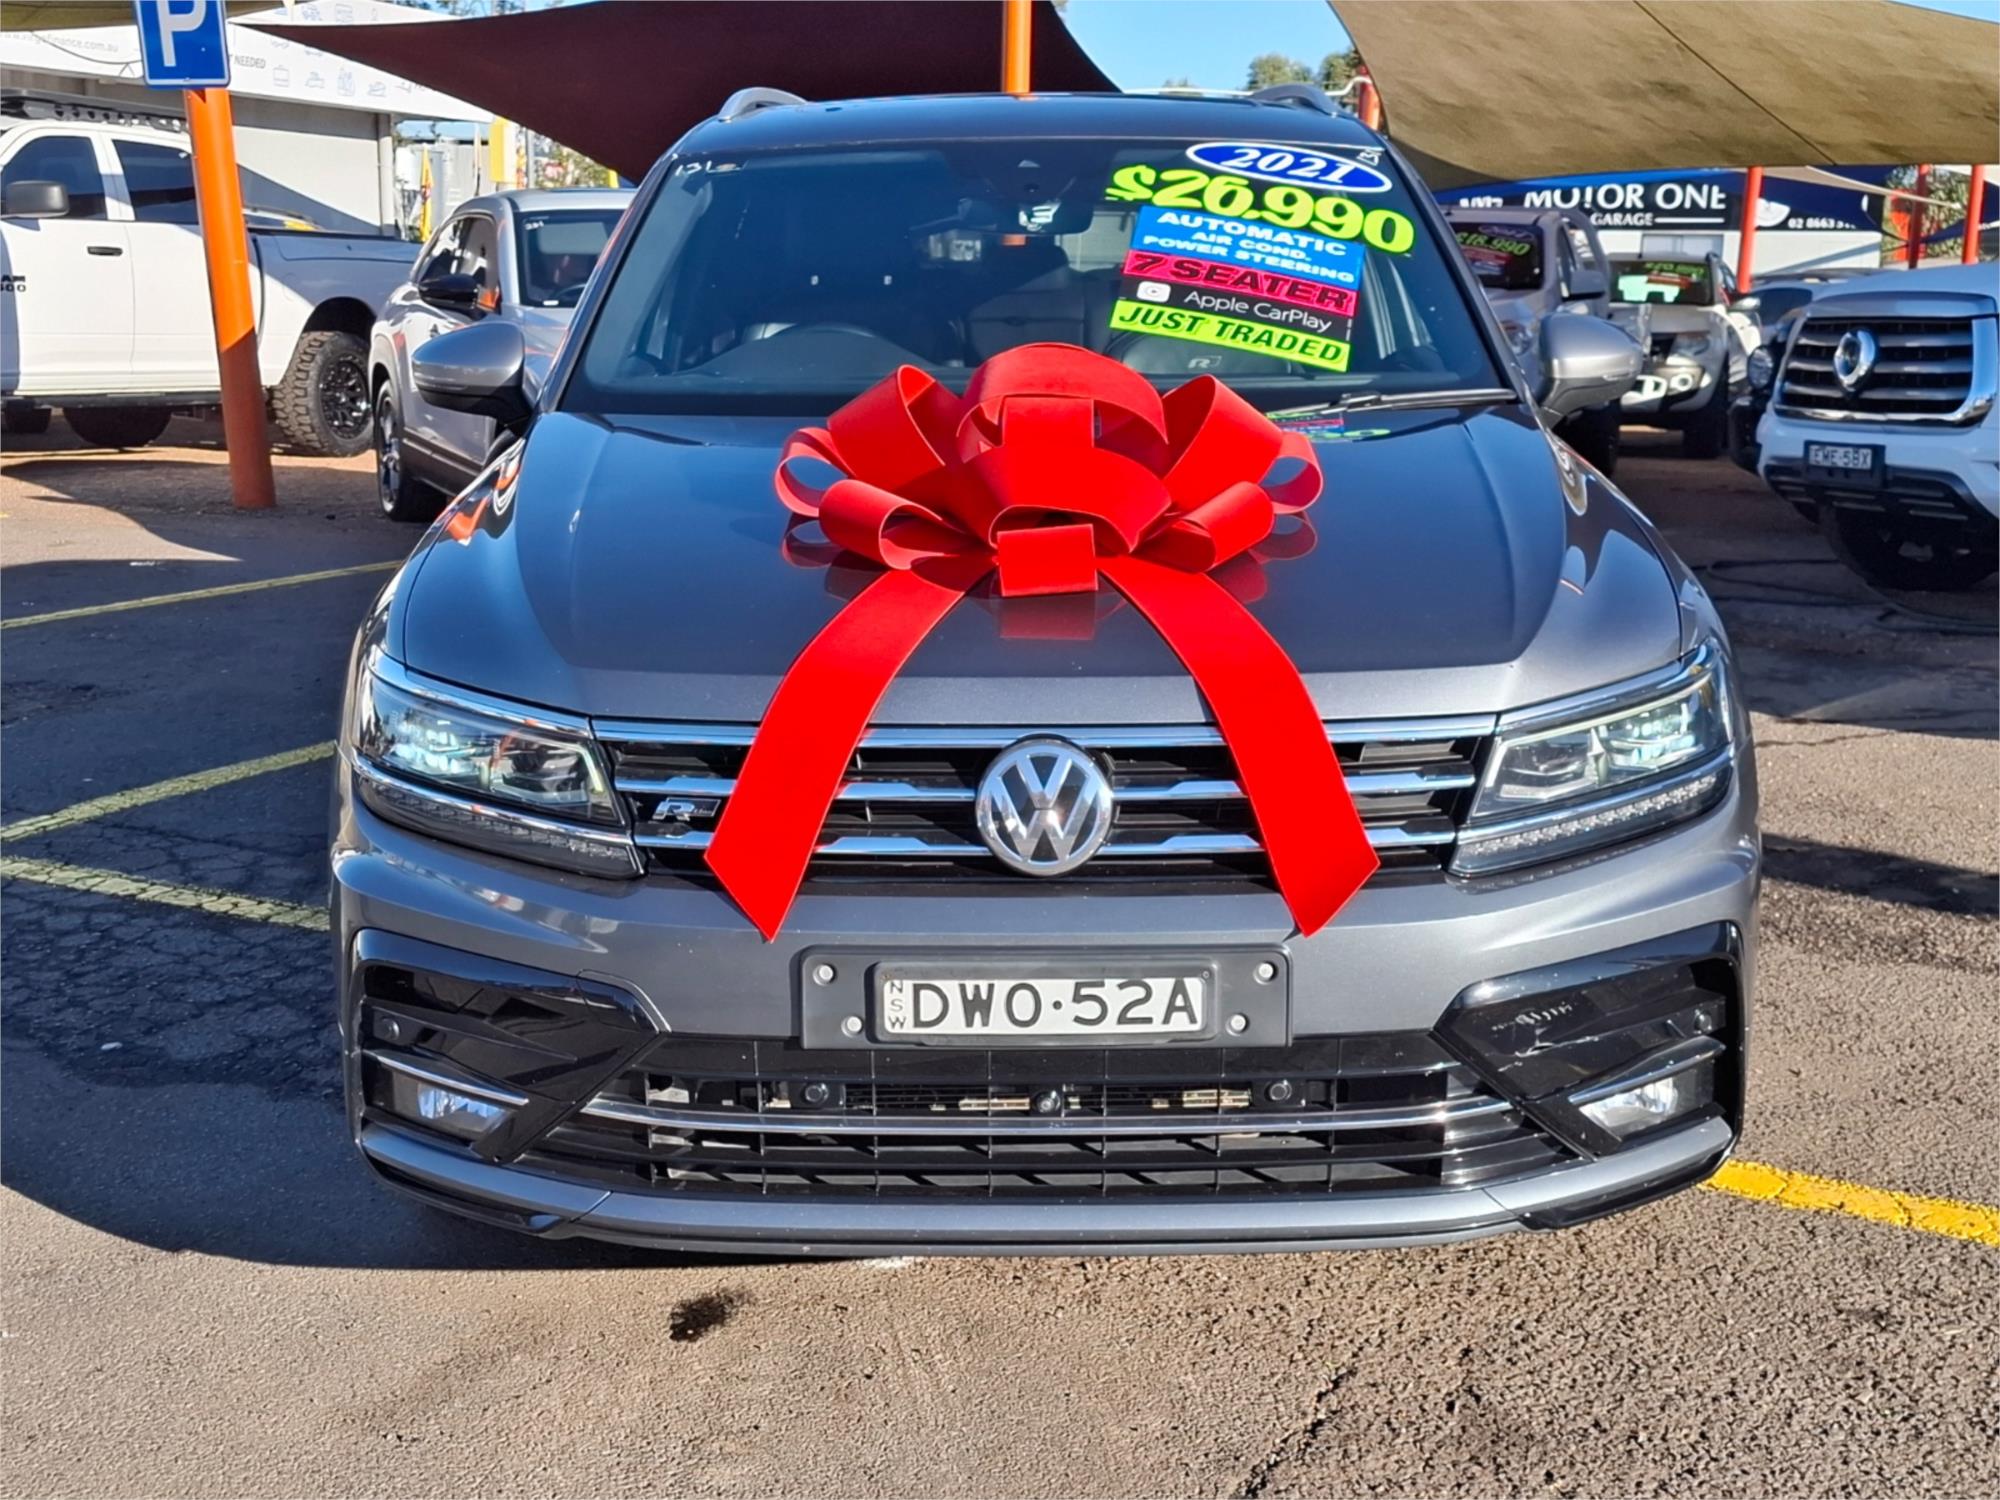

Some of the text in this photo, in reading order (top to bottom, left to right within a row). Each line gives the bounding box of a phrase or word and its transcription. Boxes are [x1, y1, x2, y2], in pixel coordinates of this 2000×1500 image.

[157, 0, 206, 67] P
[1220, 149, 1356, 184] 2021
[1524, 183, 1643, 209] MOTOR
[1655, 183, 1726, 209] ONE
[1157, 211, 1347, 256] AUTOMATIC
[1590, 212, 1653, 226] GARAGE
[1143, 235, 1355, 283] POWER STEERING
[1192, 231, 1312, 262] AIR COND.
[1129, 253, 1351, 311] 7 SEATER
[1184, 291, 1332, 333] Apple CarPlay
[1119, 306, 1342, 362] JUST TRADED
